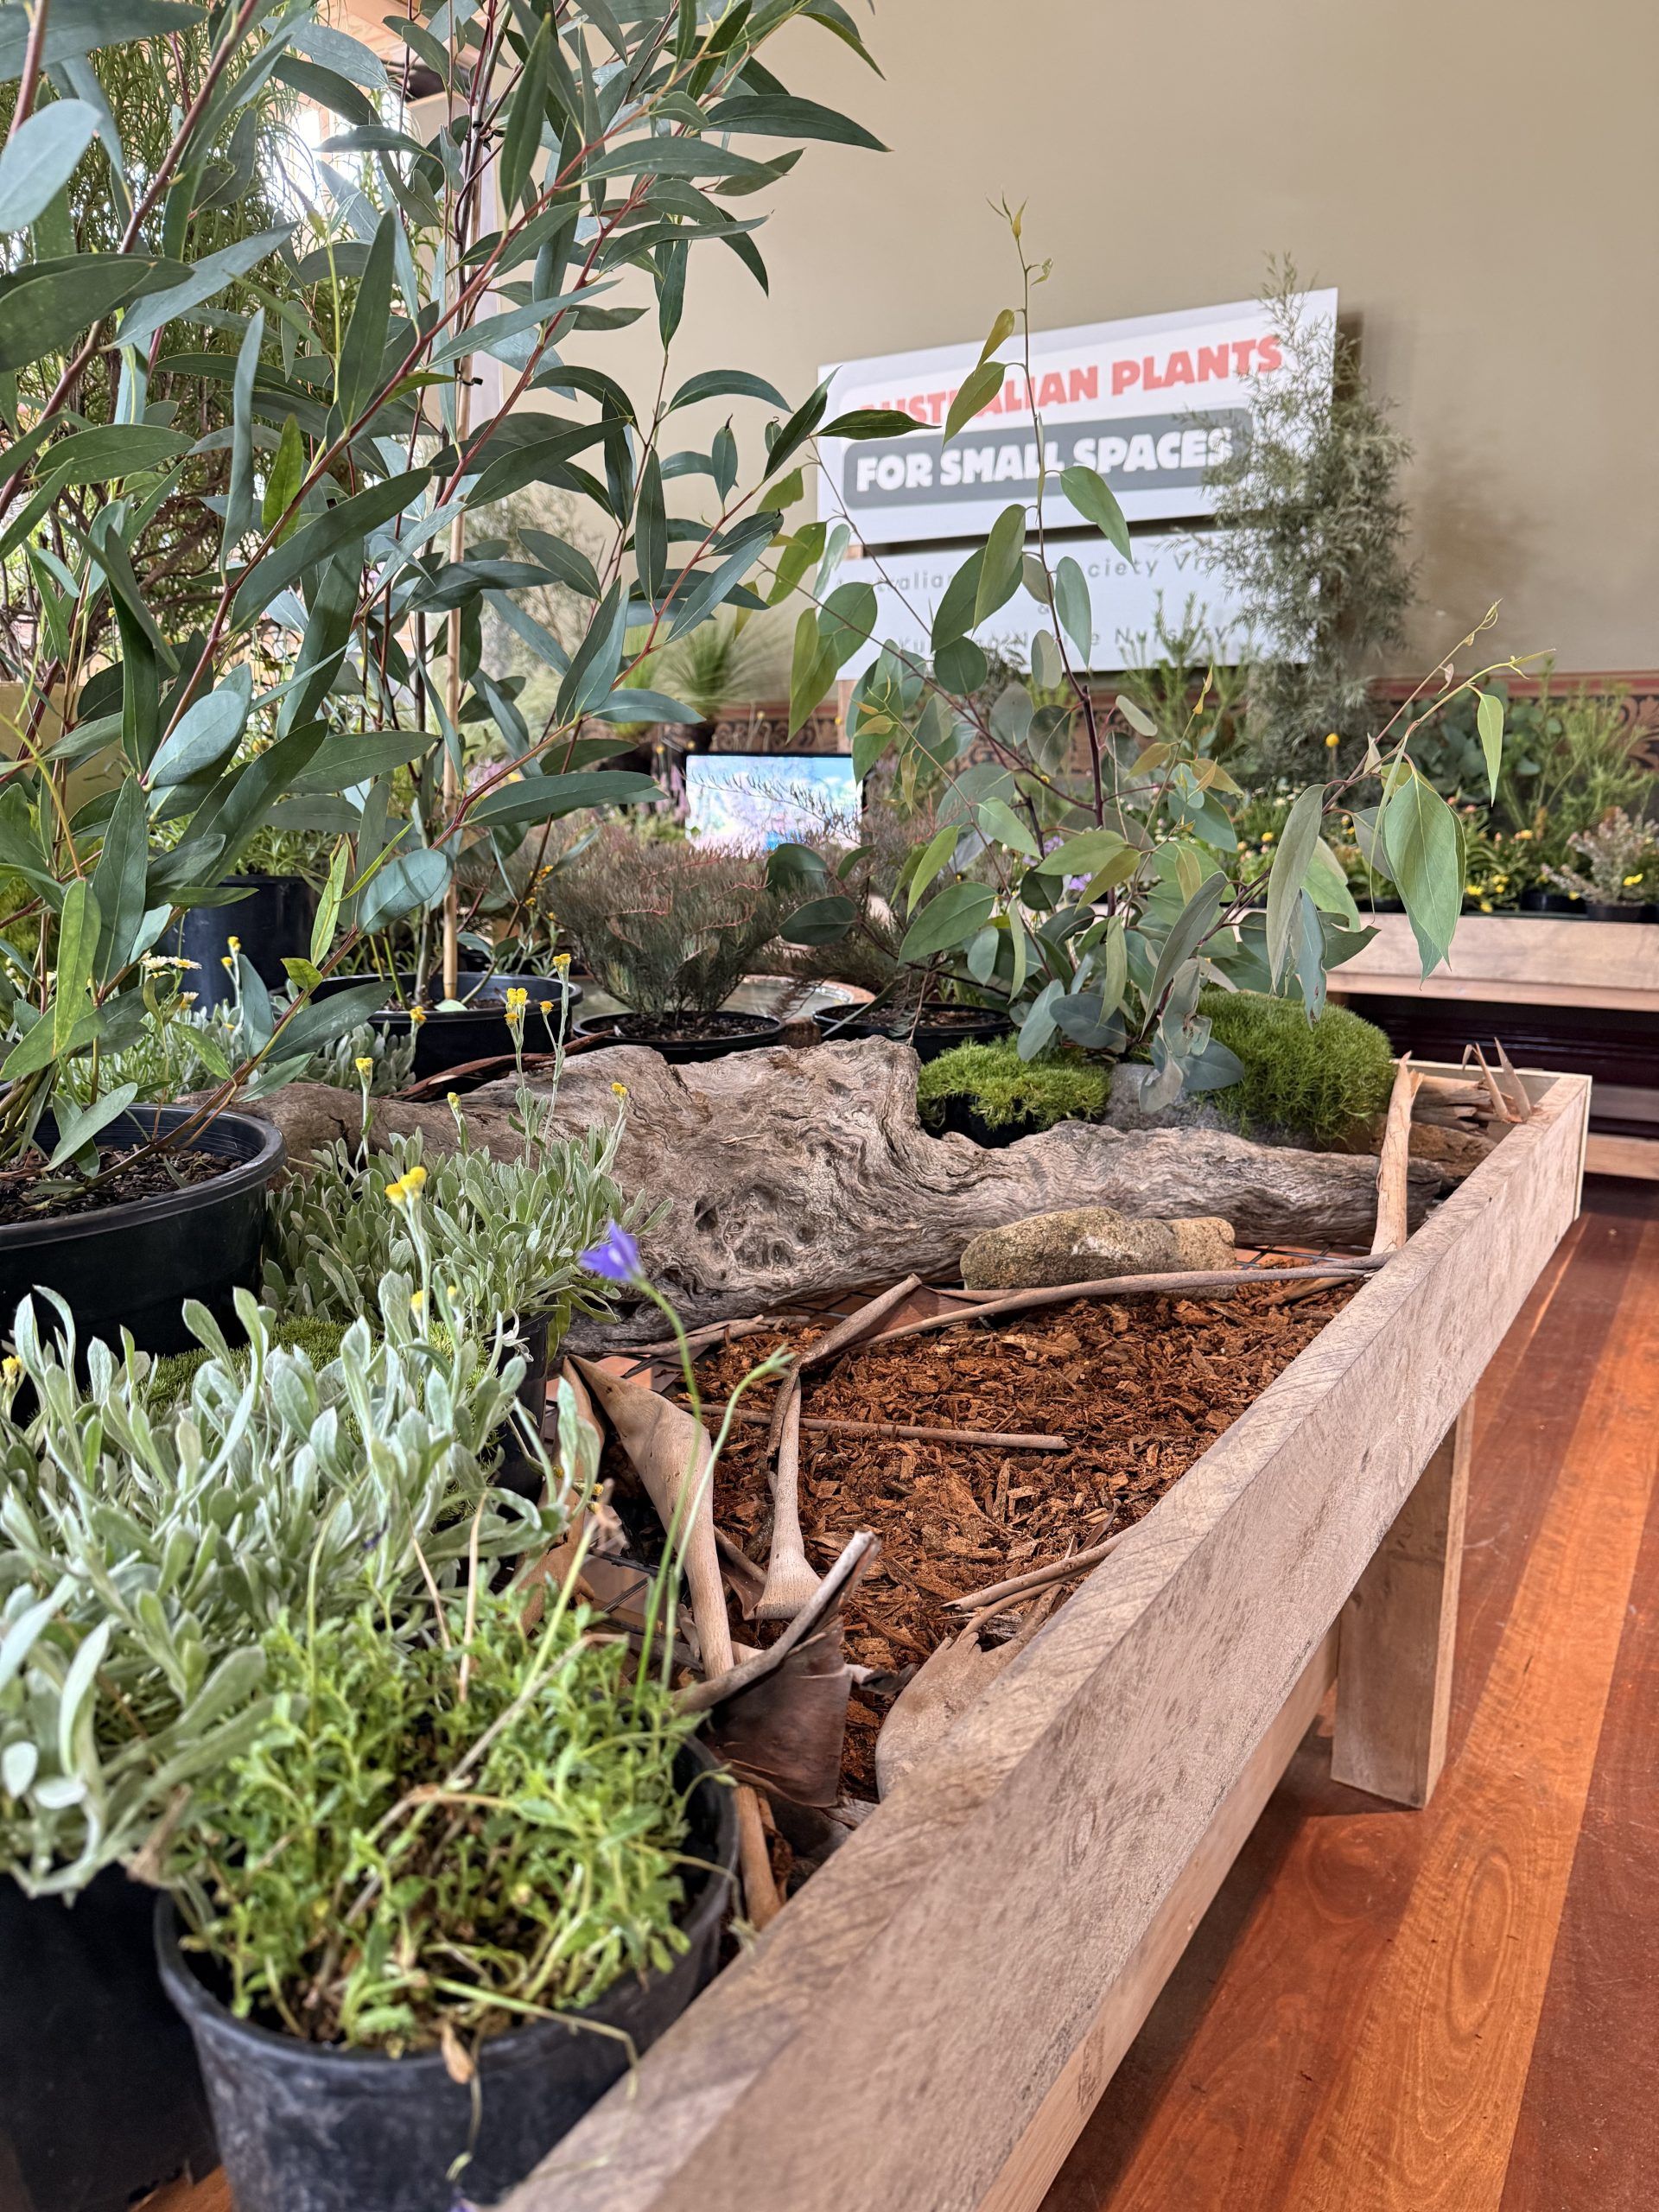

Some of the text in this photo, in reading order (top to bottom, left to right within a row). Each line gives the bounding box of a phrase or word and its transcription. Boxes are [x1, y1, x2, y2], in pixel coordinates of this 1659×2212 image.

[859, 335, 1282, 424] STLIAN PLANTS
[856, 427, 1233, 493] FOR SMALL SPACES
[1054, 557, 1159, 577] ciety
